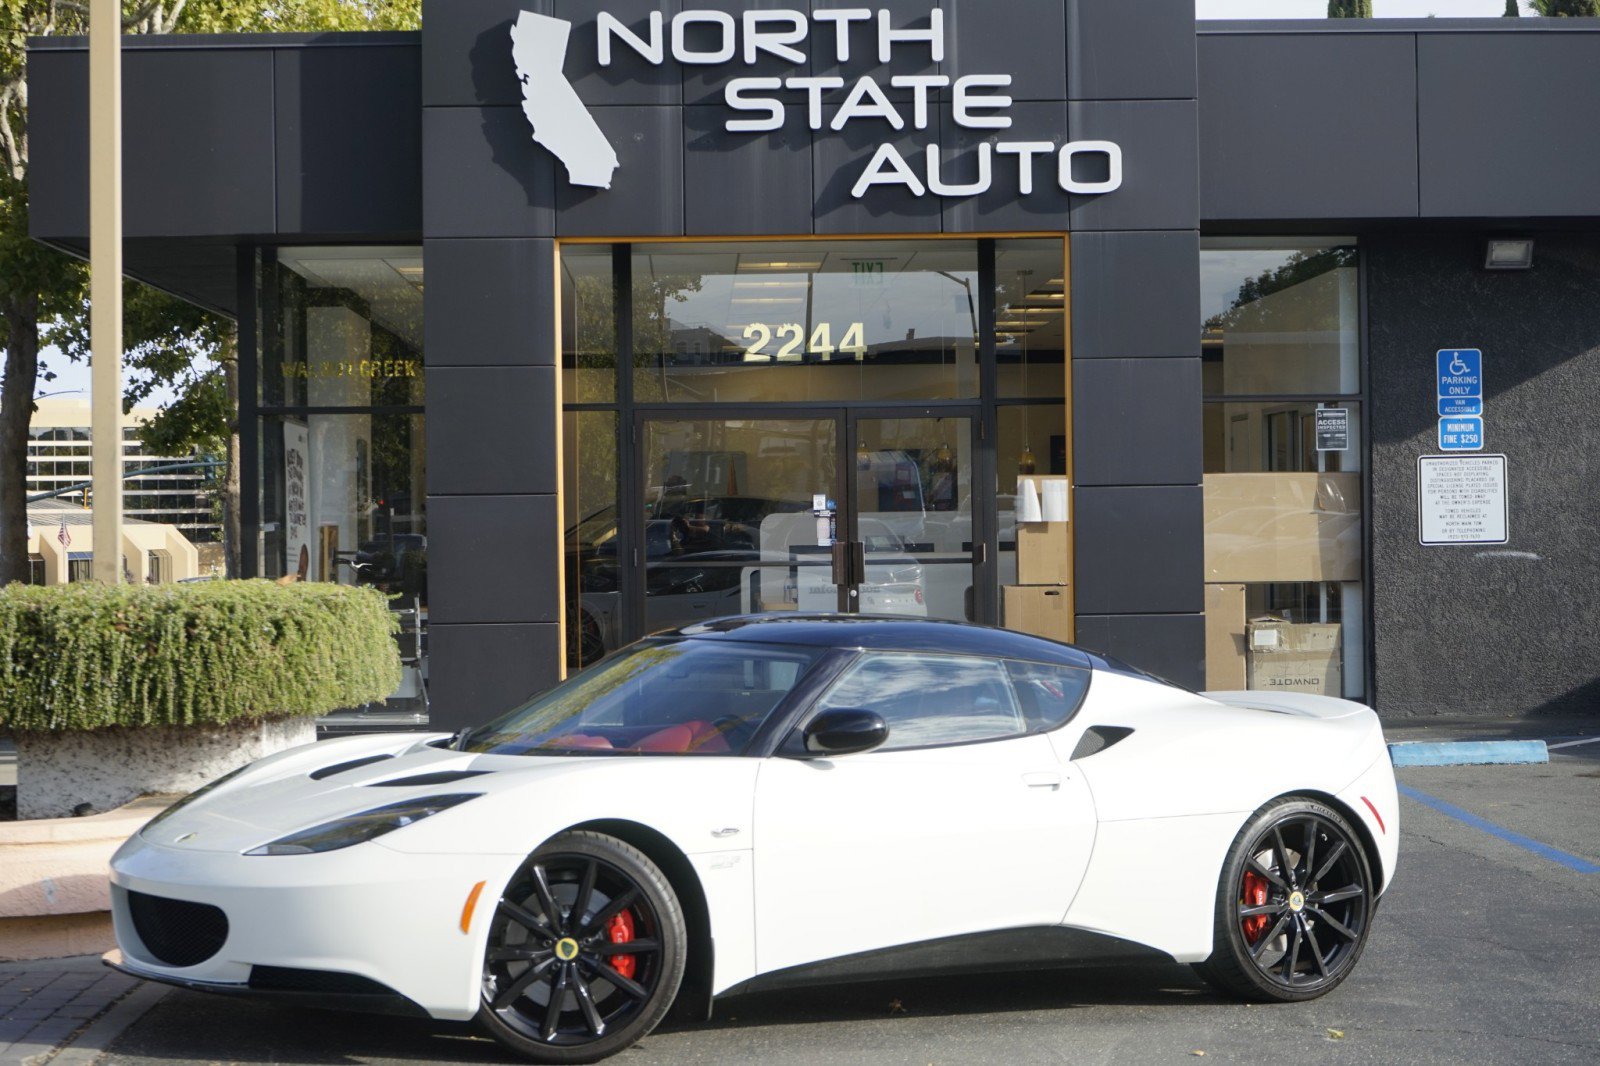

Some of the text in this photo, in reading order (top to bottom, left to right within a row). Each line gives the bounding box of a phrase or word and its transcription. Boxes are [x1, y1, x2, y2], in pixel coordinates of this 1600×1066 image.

[597, 8, 944, 65] NORTH
[725, 74, 1012, 132] STATE
[851, 140, 1122, 198] AUTO
[743, 322, 868, 362] 2244
[1441, 376, 1478, 384] PARKING
[1449, 386, 1470, 394] ONLY
[1444, 434, 1478, 444] FINE $250
[1447, 423, 1474, 432] MINIMUM
